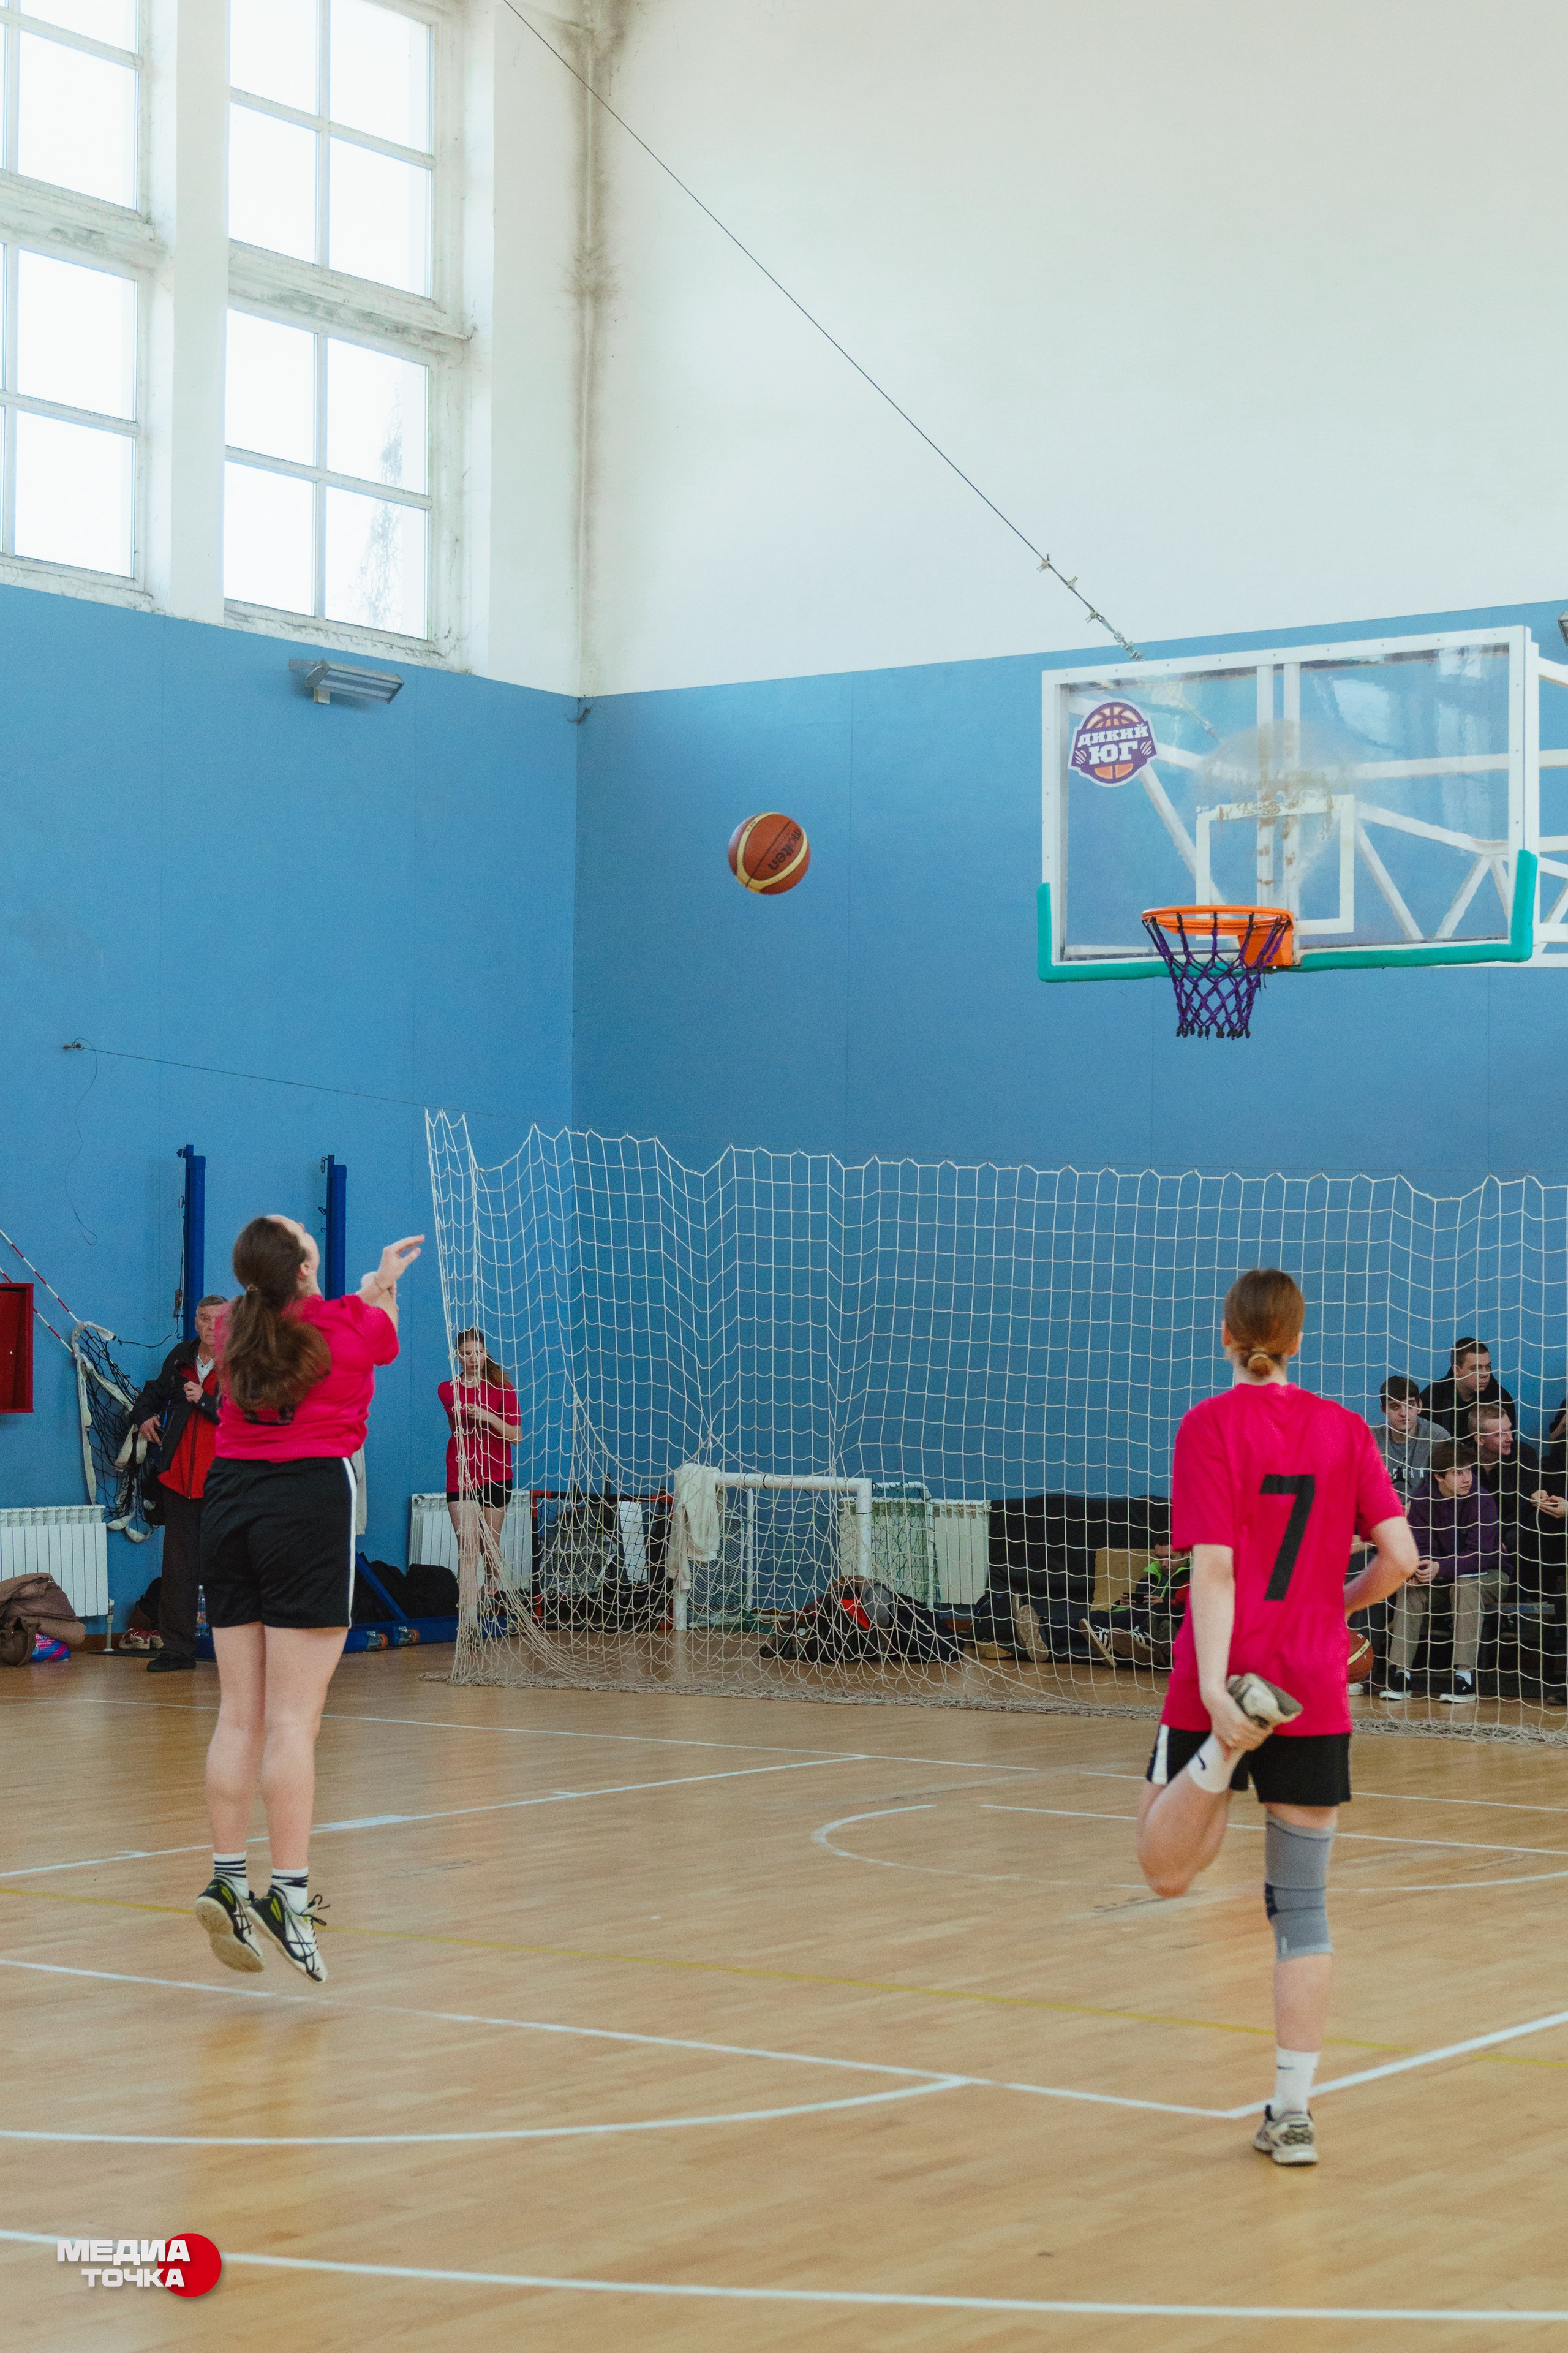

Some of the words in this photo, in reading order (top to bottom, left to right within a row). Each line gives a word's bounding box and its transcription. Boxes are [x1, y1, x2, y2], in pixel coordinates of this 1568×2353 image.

[1077, 723, 1148, 747] ДИКИЙ
[1088, 741, 1139, 765] ЮГ
[767, 828, 801, 870] mlten
[1259, 1473, 1316, 1601] 7
